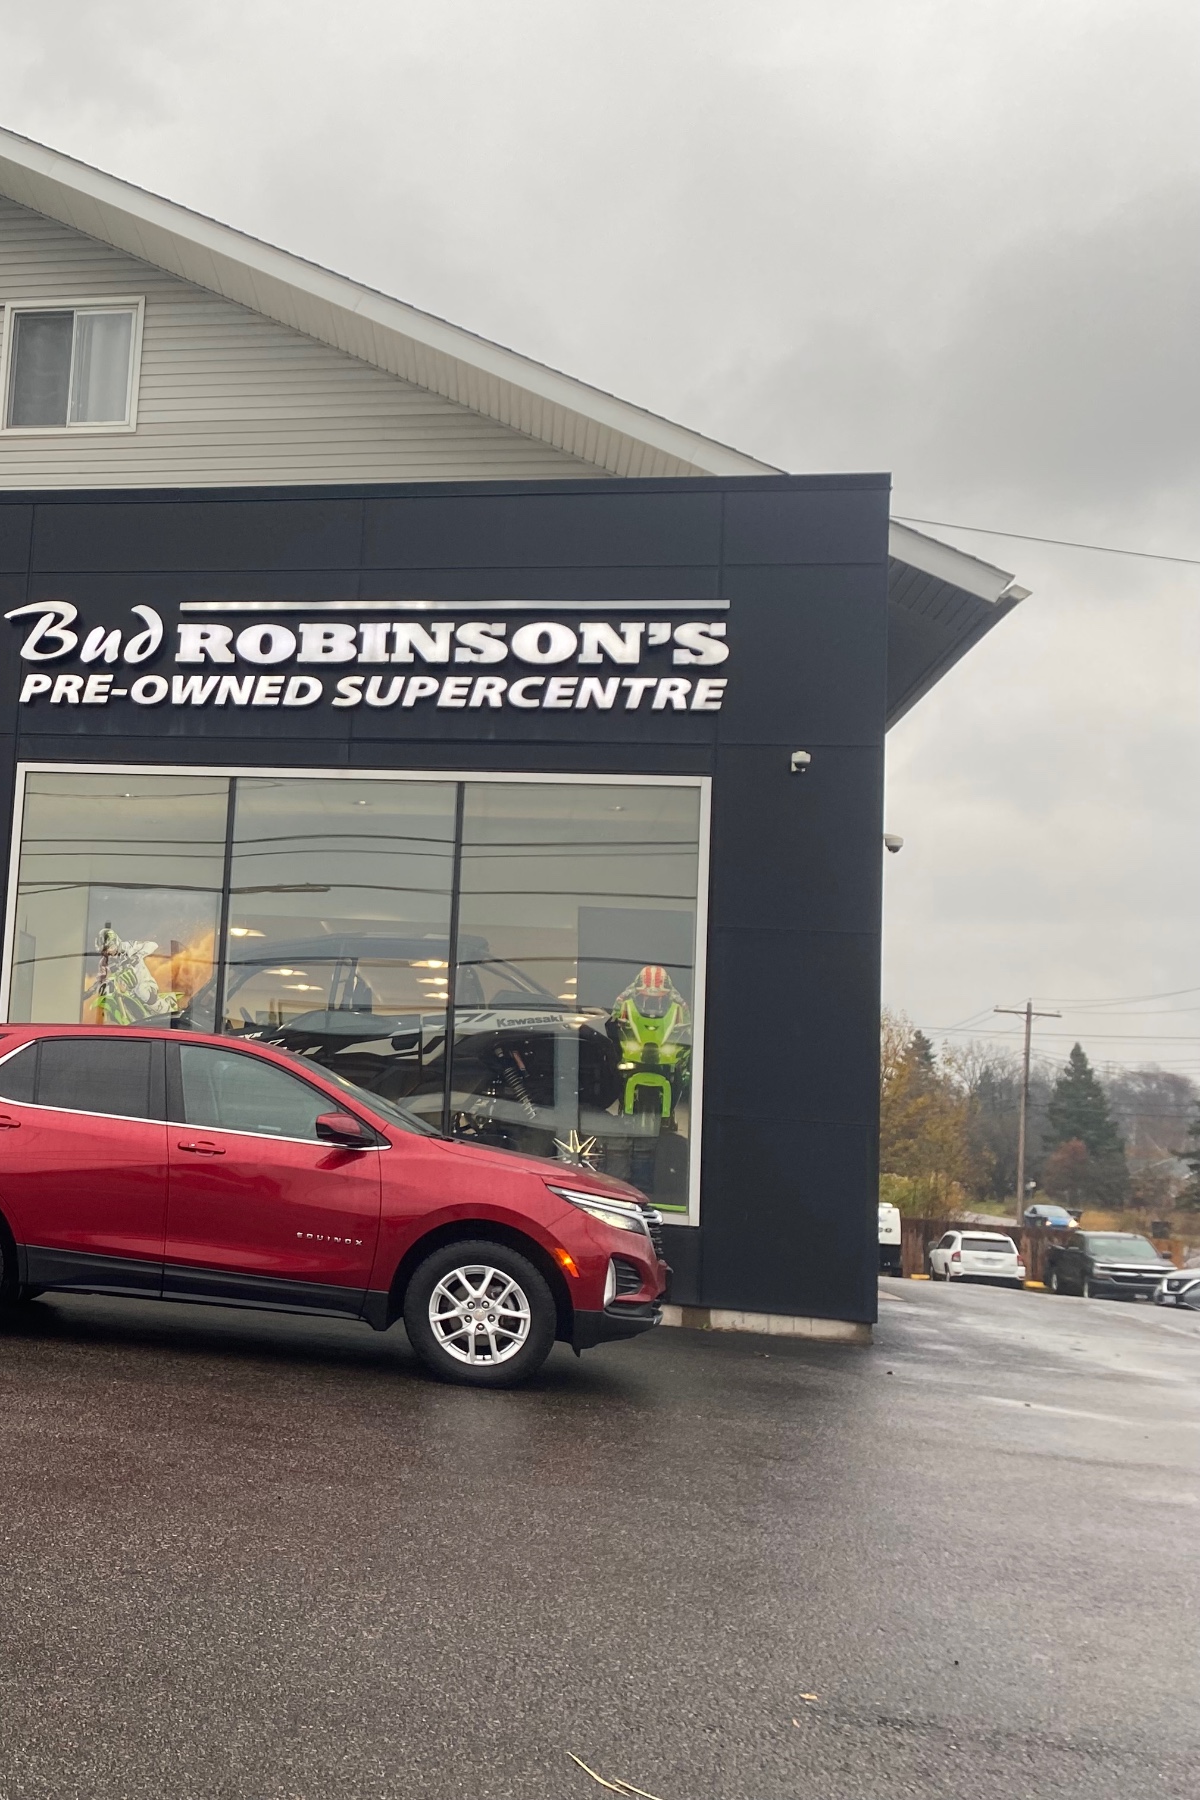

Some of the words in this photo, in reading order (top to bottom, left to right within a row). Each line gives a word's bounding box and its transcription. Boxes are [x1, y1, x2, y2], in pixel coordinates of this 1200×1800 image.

[4, 600, 164, 665] Bud
[175, 621, 730, 666] ROBINSON'S
[19, 673, 324, 707] PRE-OWNED
[332, 675, 729, 711] SUPERCENTRE
[496, 1014, 564, 1028] Kawasaki
